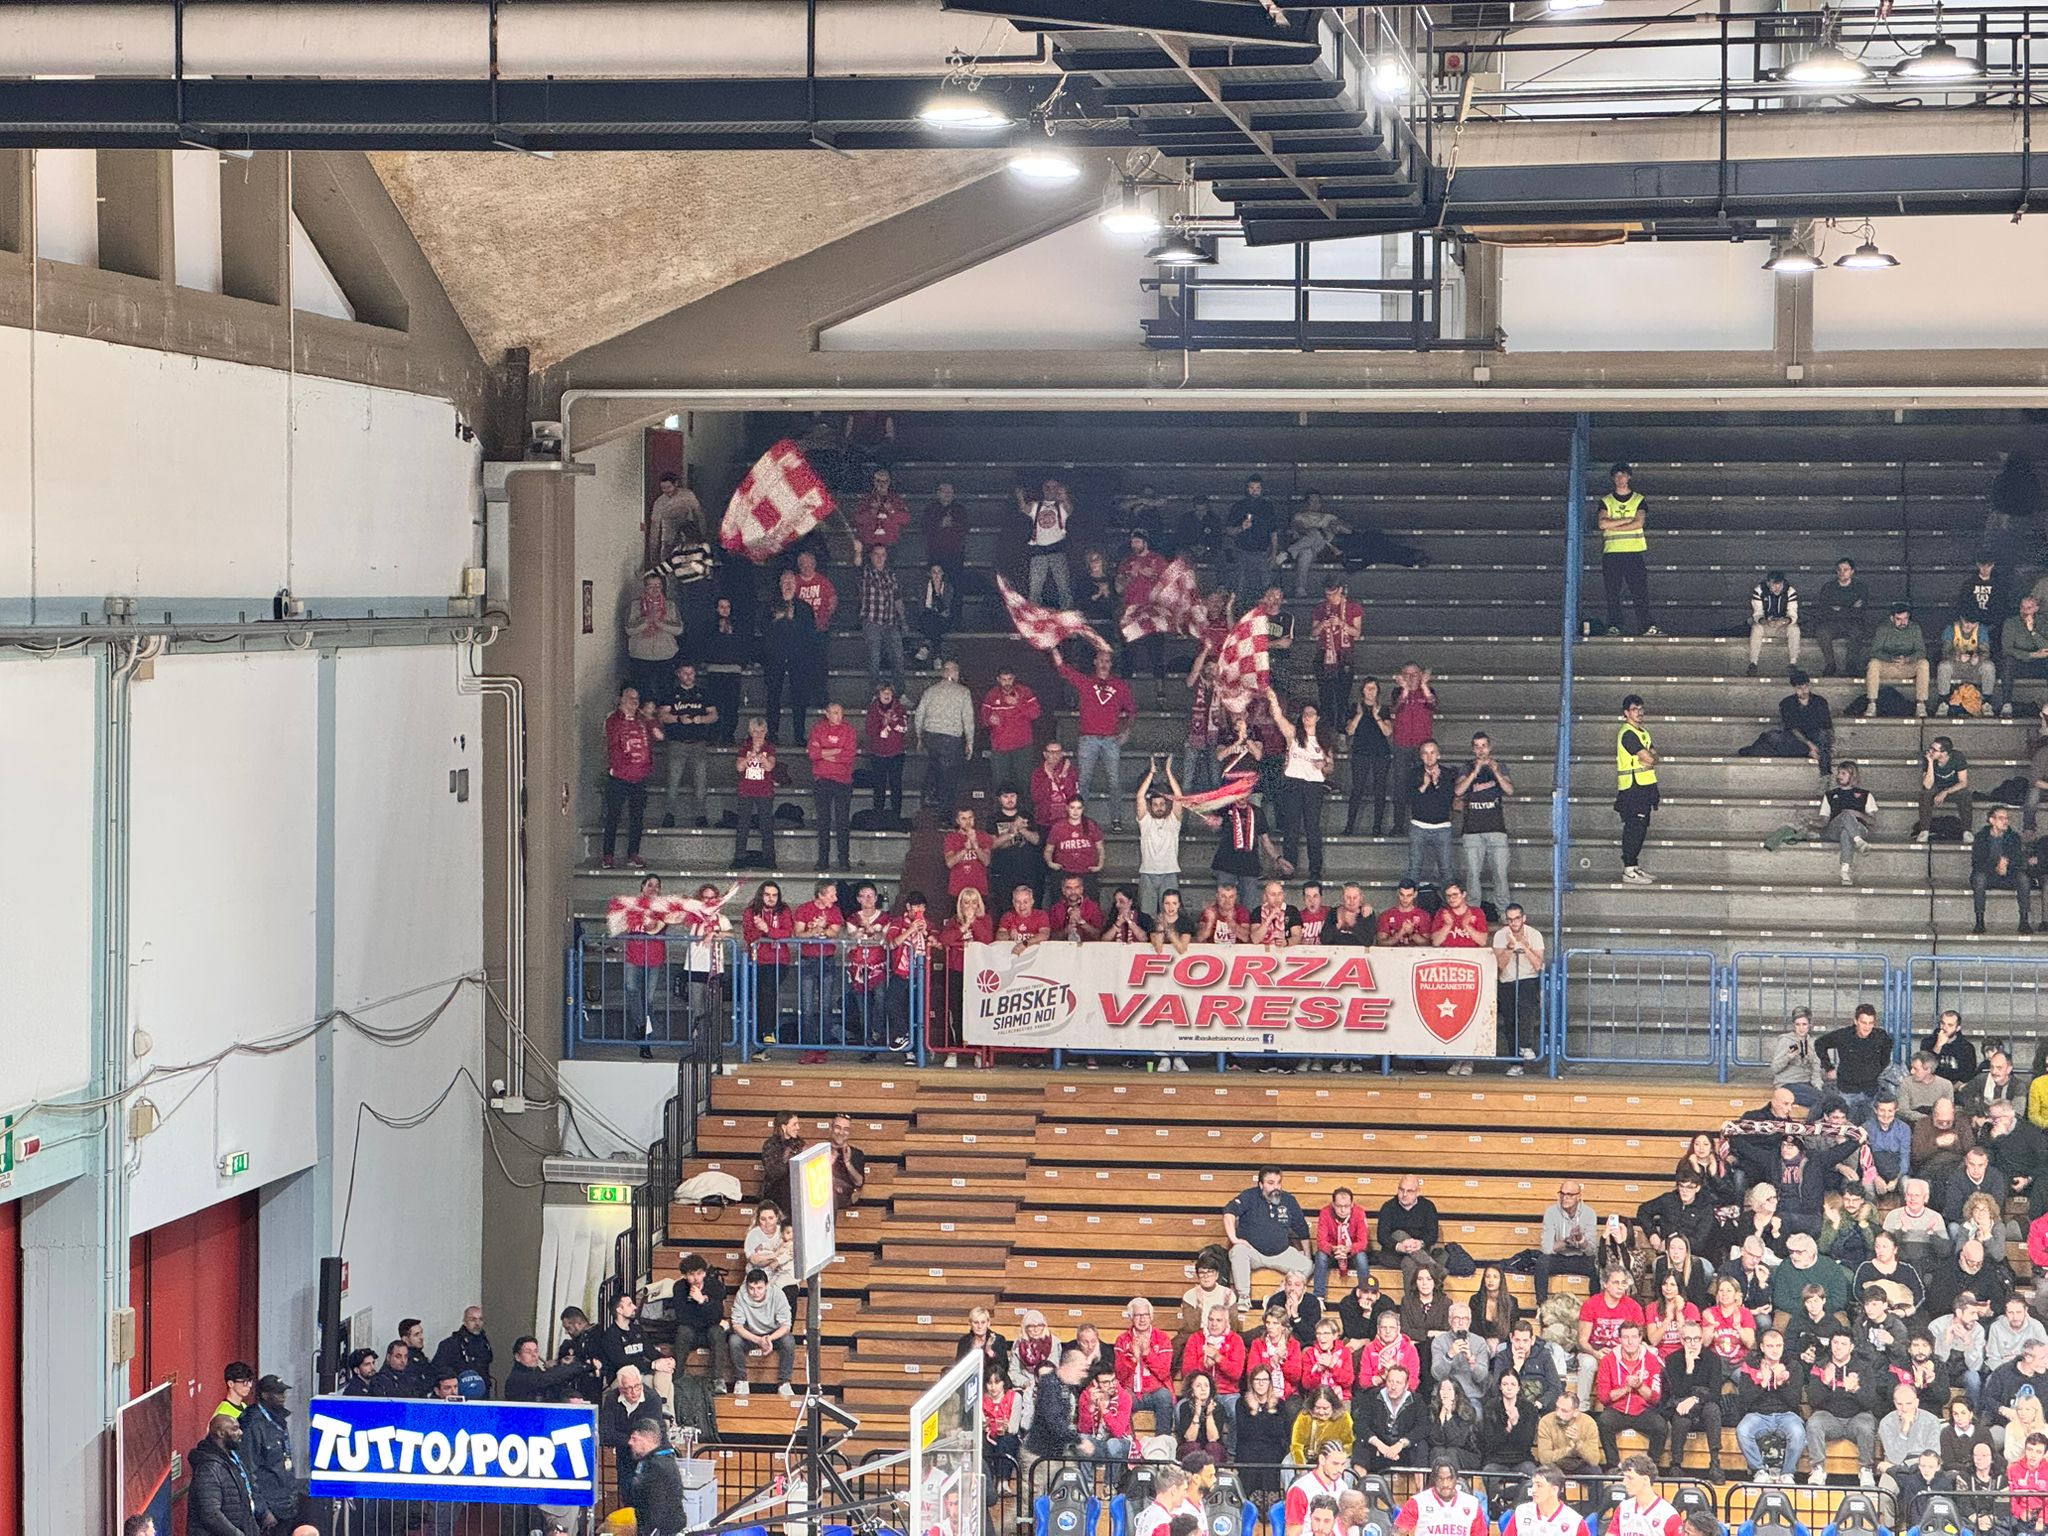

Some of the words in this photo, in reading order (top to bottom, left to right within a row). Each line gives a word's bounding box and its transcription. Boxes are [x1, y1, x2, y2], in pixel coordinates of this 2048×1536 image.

[1127, 953, 1377, 990] FORZA
[1418, 966, 1476, 983] VARESE
[1419, 983, 1476, 991] PALLACANESTRO
[980, 998, 994, 1018] IL
[997, 984, 1071, 1015] BASKET
[1098, 992, 1392, 1030] VARESE
[993, 1012, 1031, 1030] SIAMO
[1034, 1007, 1056, 1023] NOI
[311, 1413, 592, 1480] TUTTOSPORT
